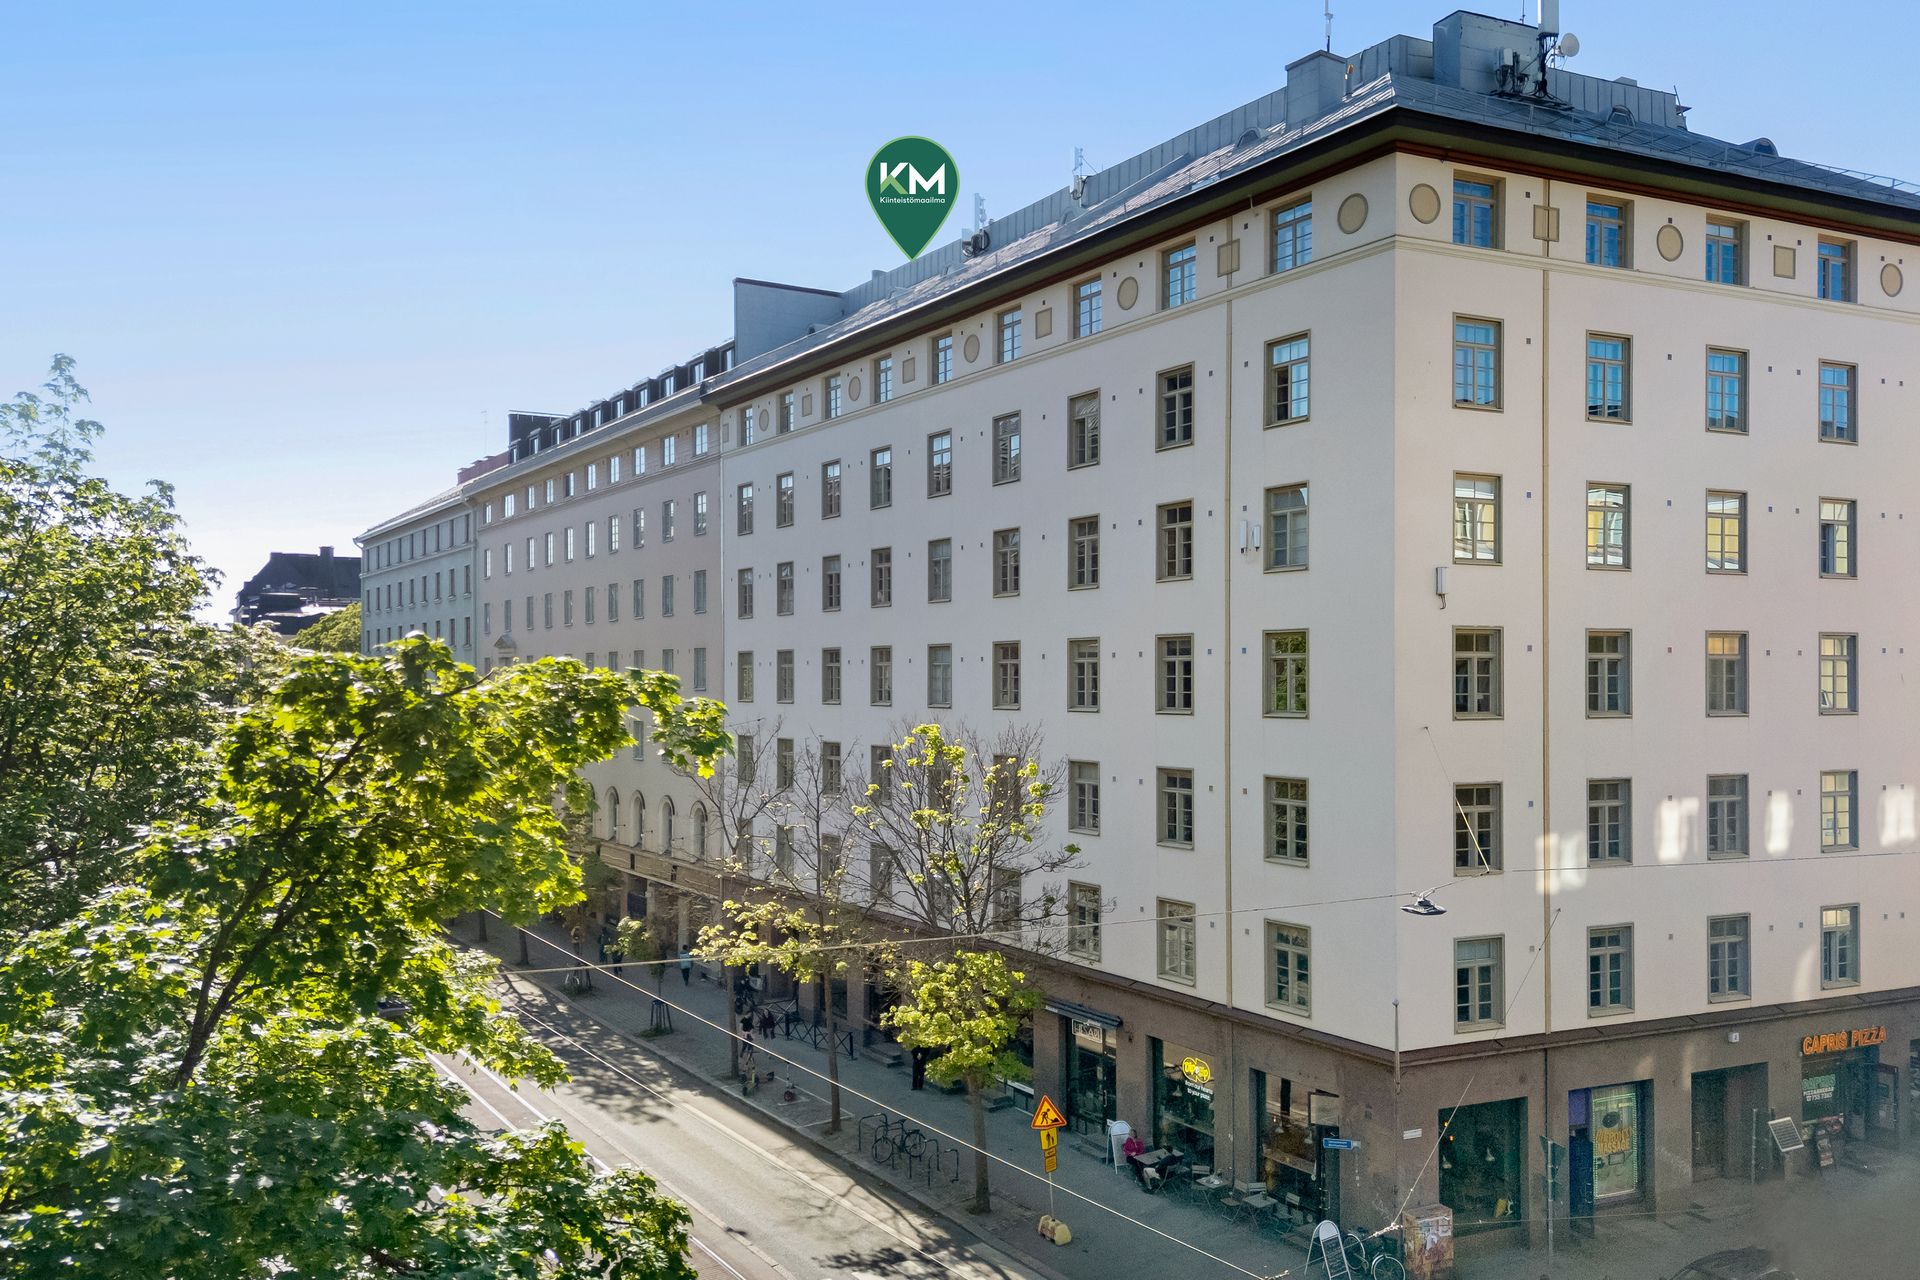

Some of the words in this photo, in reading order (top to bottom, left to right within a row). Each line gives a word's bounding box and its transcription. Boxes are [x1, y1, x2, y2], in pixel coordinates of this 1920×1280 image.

[1803, 1031, 1847, 1055] CAPRIS
[1851, 1026, 1886, 1048] PIZZA
[1802, 1074, 1835, 1090] CAPRIS
[1597, 1139, 1630, 1155] MASSAGE
